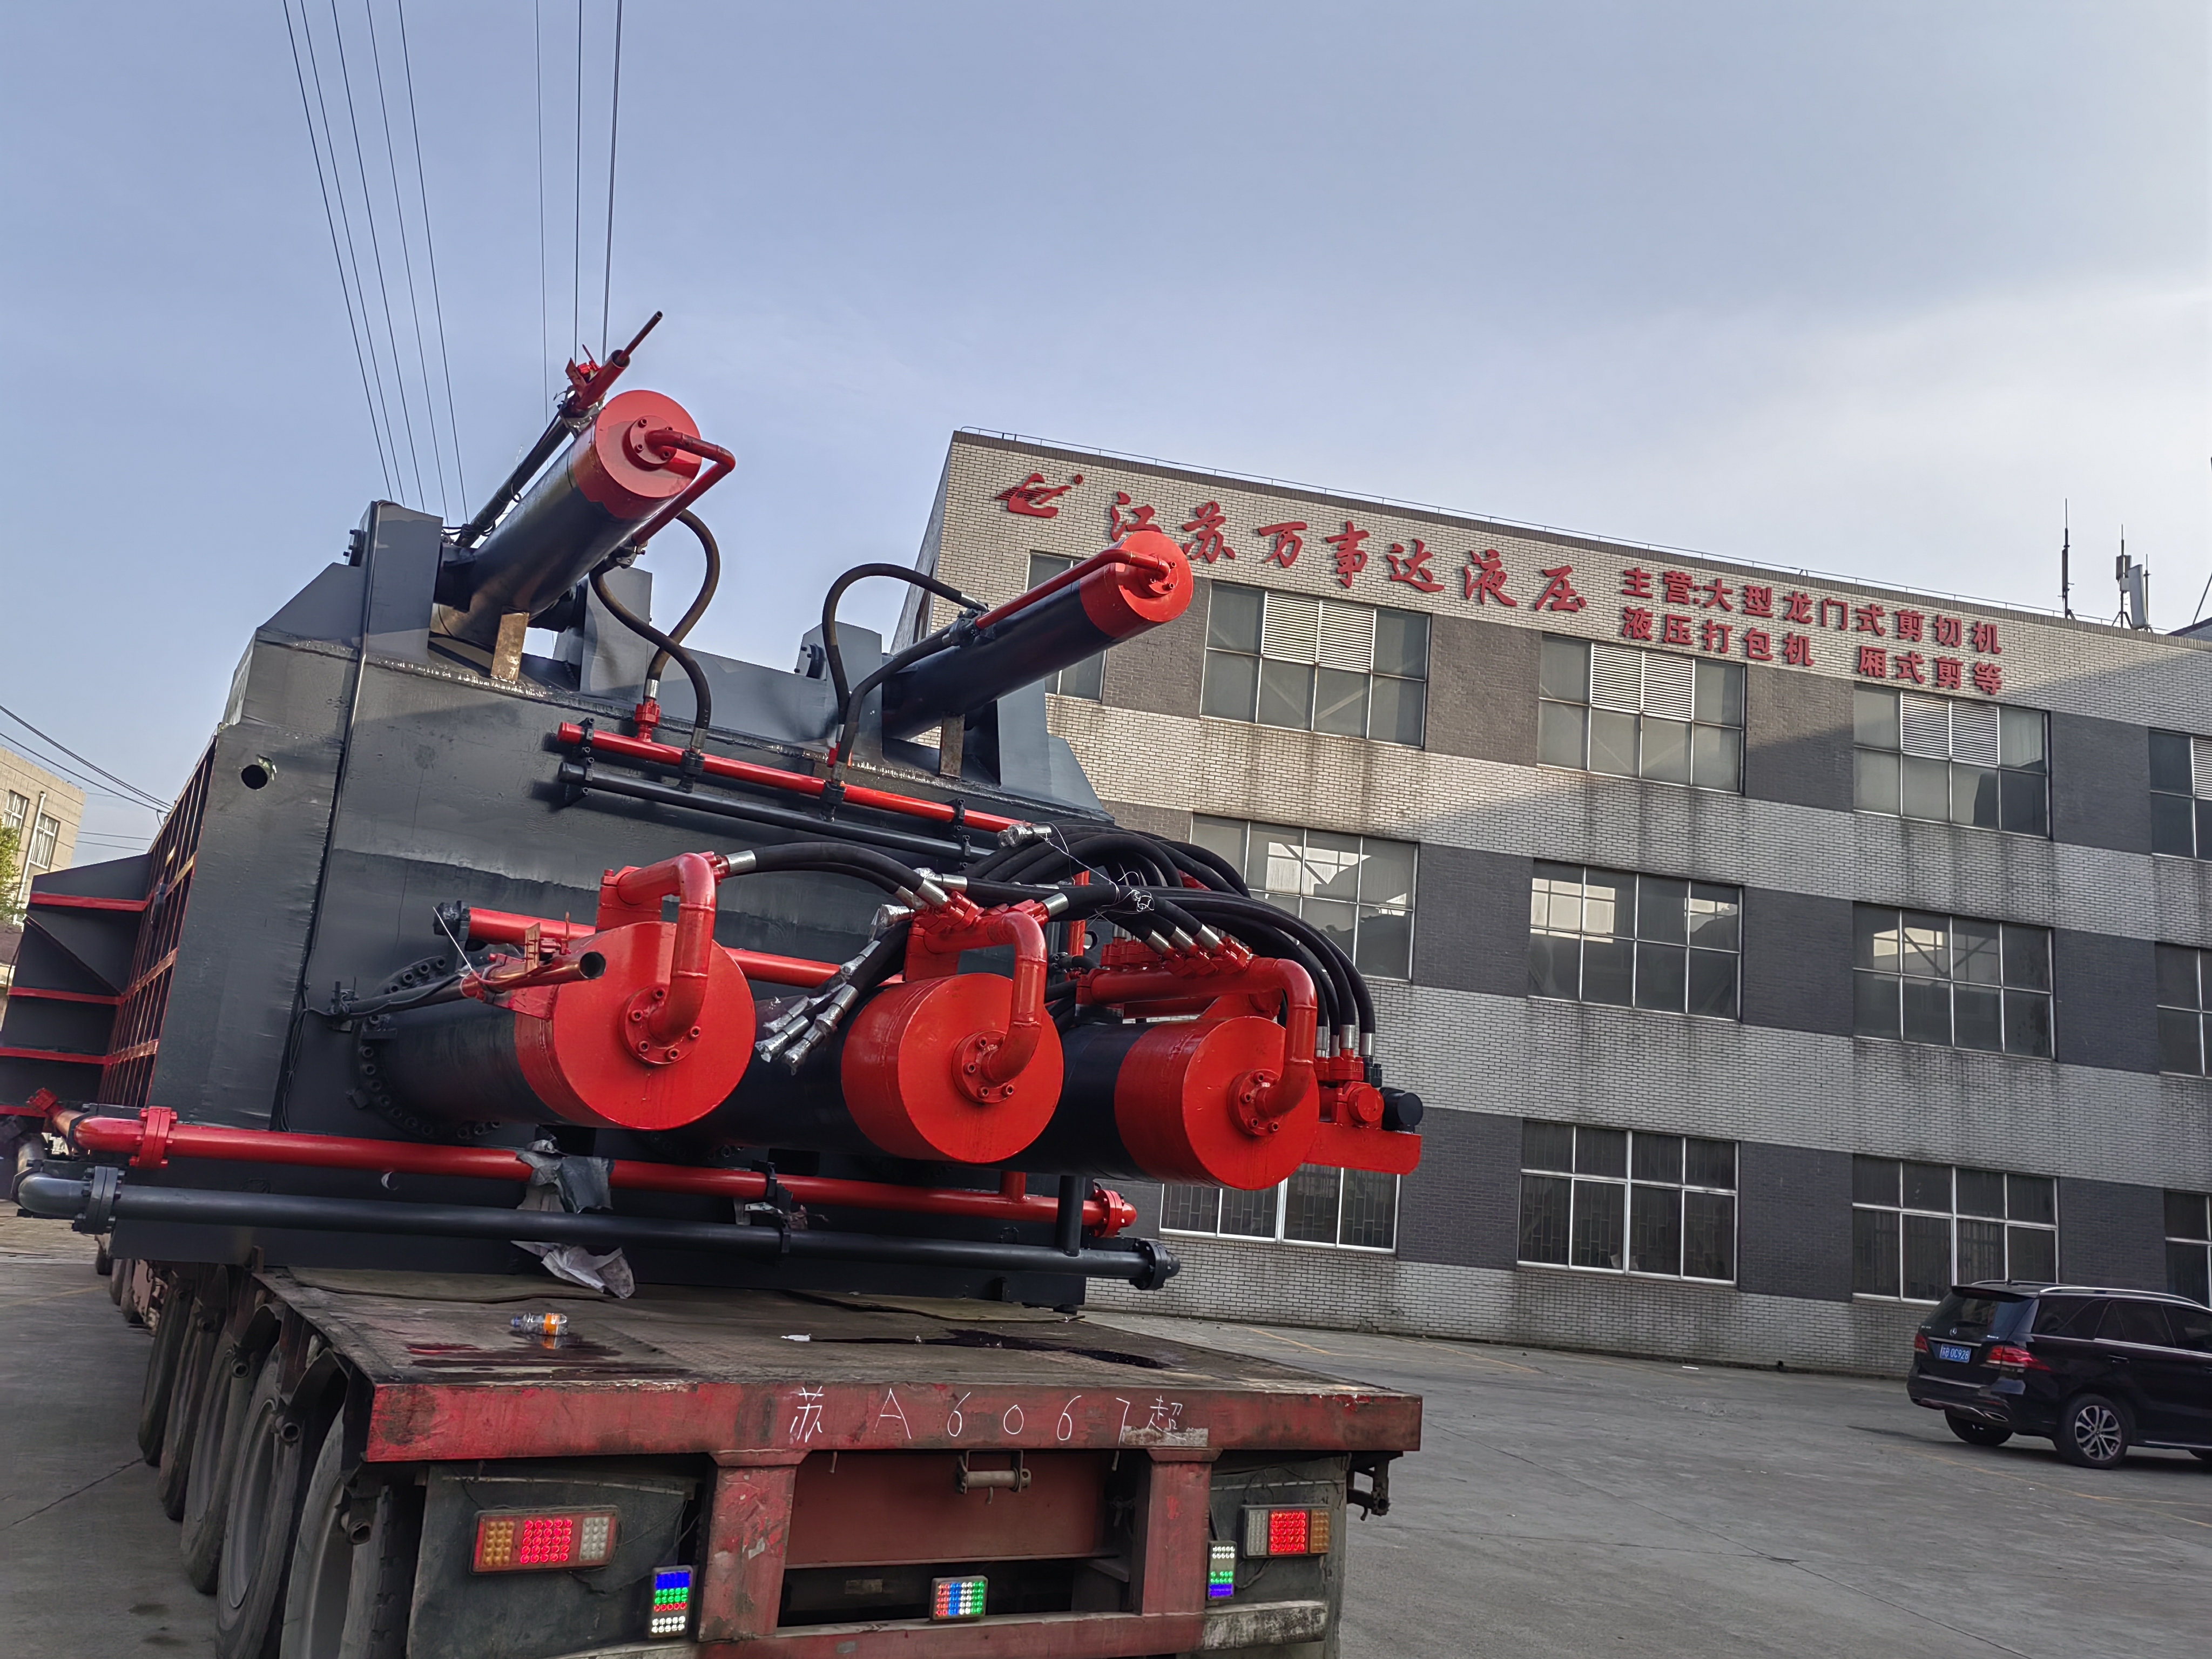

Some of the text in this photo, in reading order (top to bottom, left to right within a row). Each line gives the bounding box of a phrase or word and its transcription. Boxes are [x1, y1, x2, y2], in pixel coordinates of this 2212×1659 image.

[1110, 490, 1587, 612] 江苏万事达液压
[1622, 606, 1814, 667] 液压打包机
